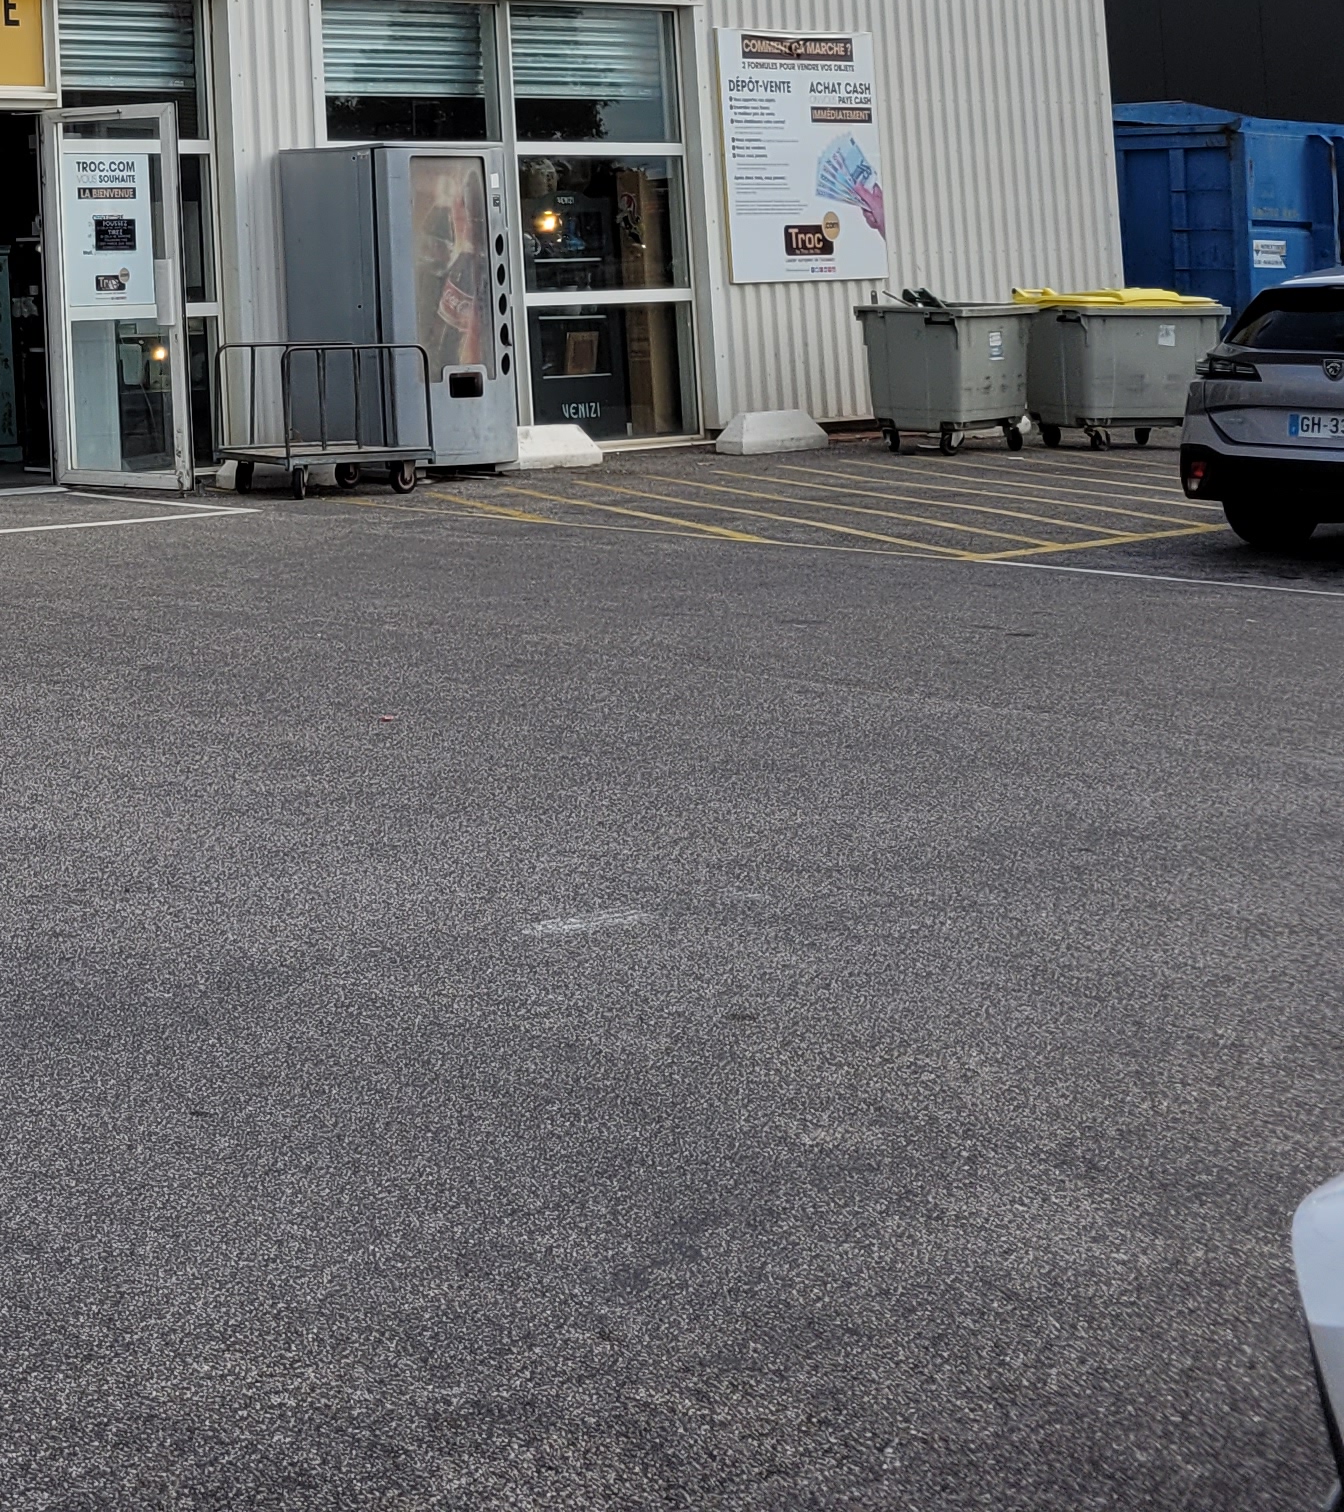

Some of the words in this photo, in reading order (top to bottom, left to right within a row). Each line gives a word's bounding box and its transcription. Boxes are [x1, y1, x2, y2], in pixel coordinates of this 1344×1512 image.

[806, 42, 845, 56] MARCHE
[846, 44, 852, 56] ?
[728, 76, 792, 94] DÉPÔT-VENTE
[809, 81, 842, 94] ACHAT
[844, 82, 871, 95] CASH
[76, 161, 136, 172] TROC.COM
[98, 174, 136, 184] SOUHAITE
[80, 188, 91, 198] LA
[92, 188, 134, 198] BIENVENUE
[788, 228, 824, 248] Troc
